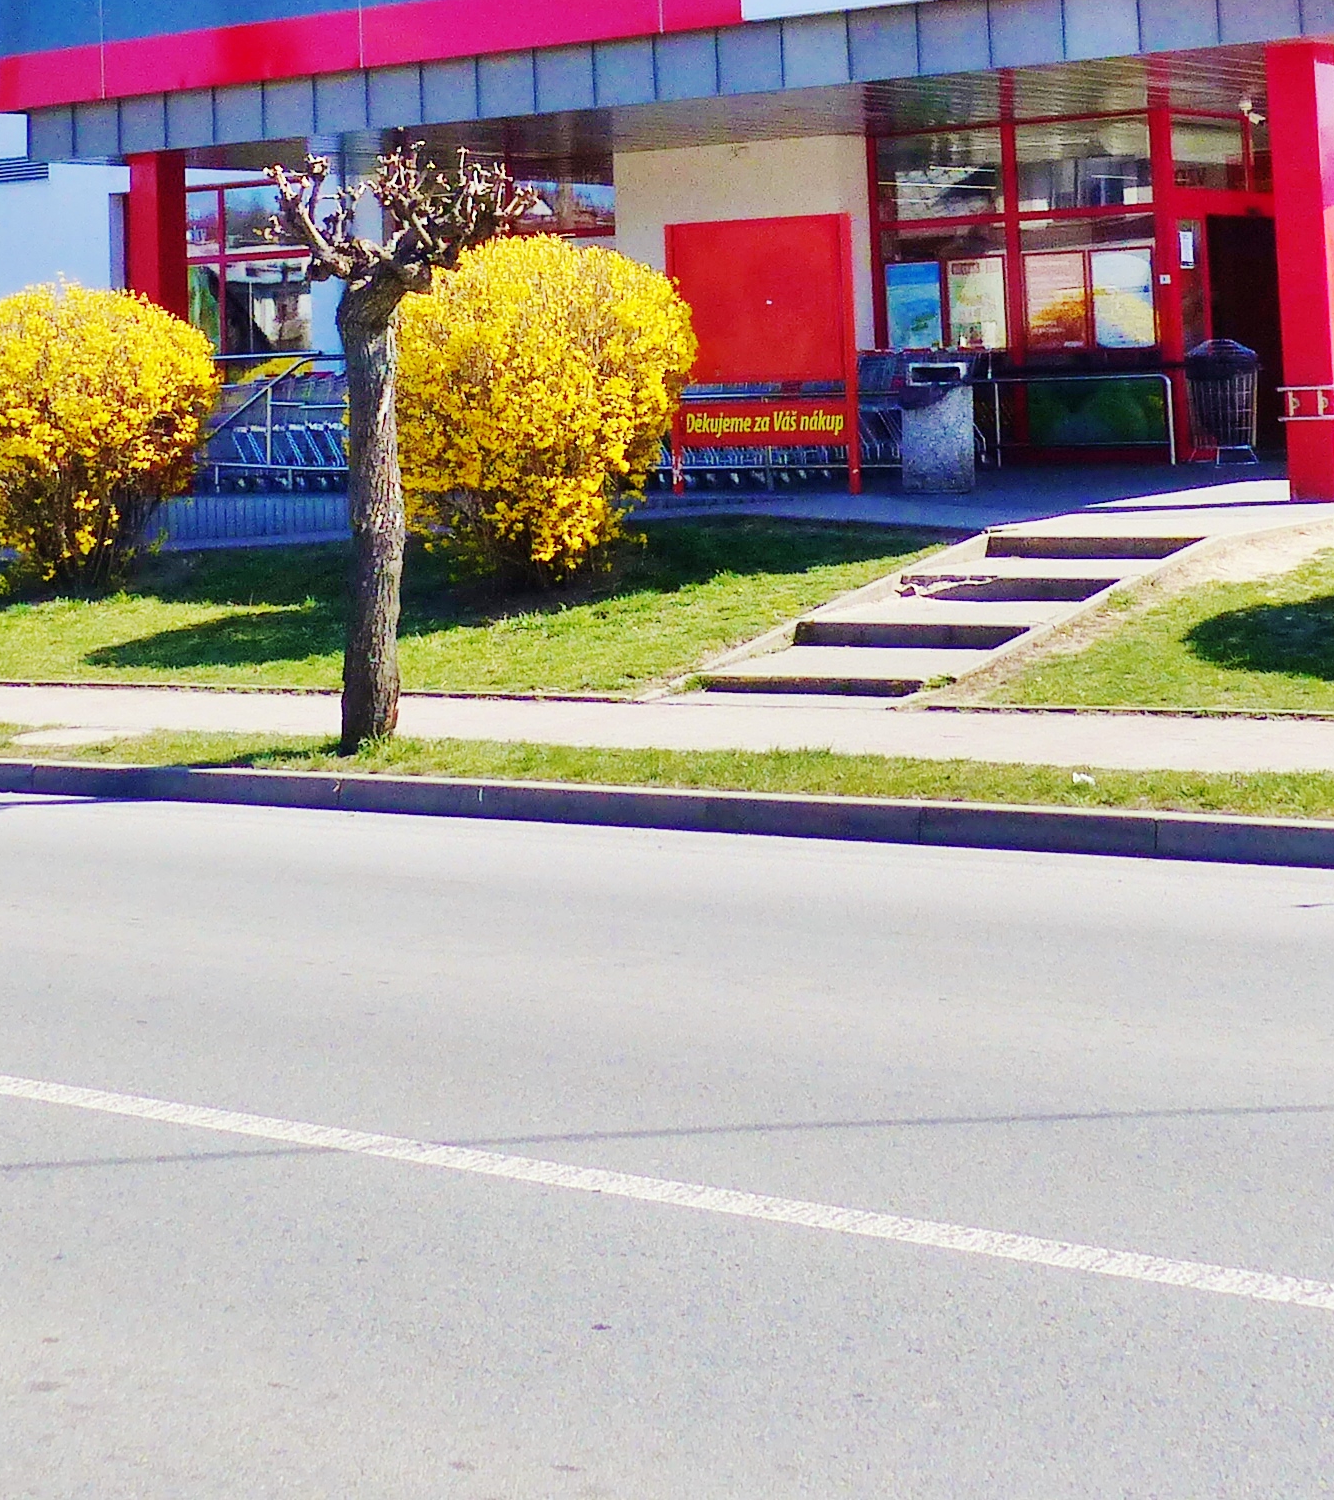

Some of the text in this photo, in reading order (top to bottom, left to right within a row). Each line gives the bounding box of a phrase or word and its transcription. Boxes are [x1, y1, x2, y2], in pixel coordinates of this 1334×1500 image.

[686, 410, 844, 438] Děkujeme za Váš nákup
